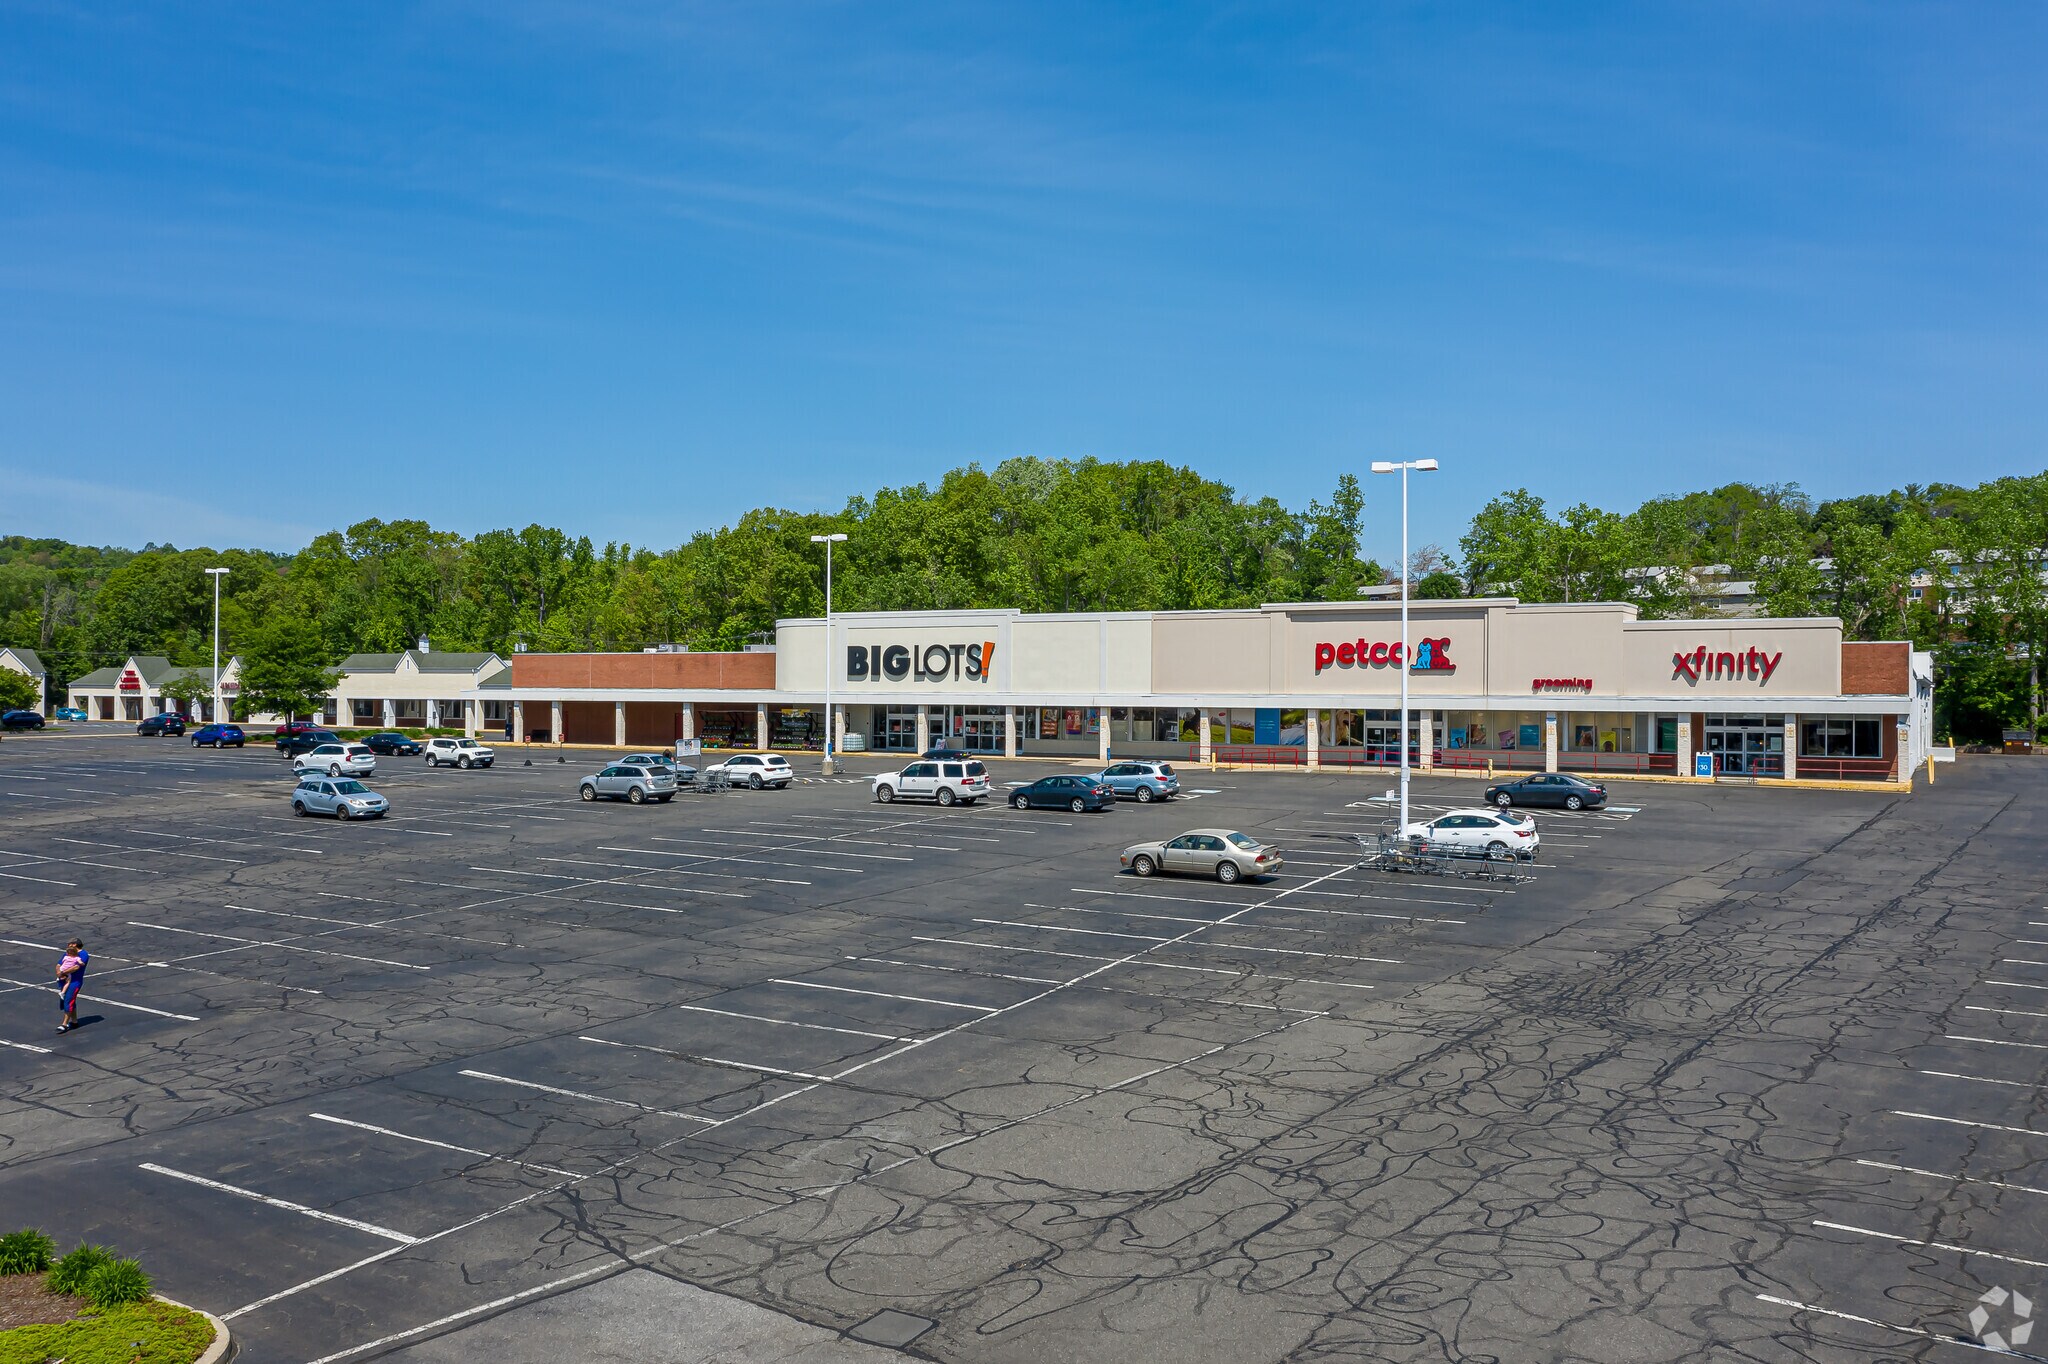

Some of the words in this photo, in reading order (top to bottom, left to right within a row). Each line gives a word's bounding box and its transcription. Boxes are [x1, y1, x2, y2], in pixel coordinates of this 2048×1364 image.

[1315, 638, 1412, 671] petco
[1674, 645, 1783, 680] xfinity
[1532, 677, 1593, 689] grooming
